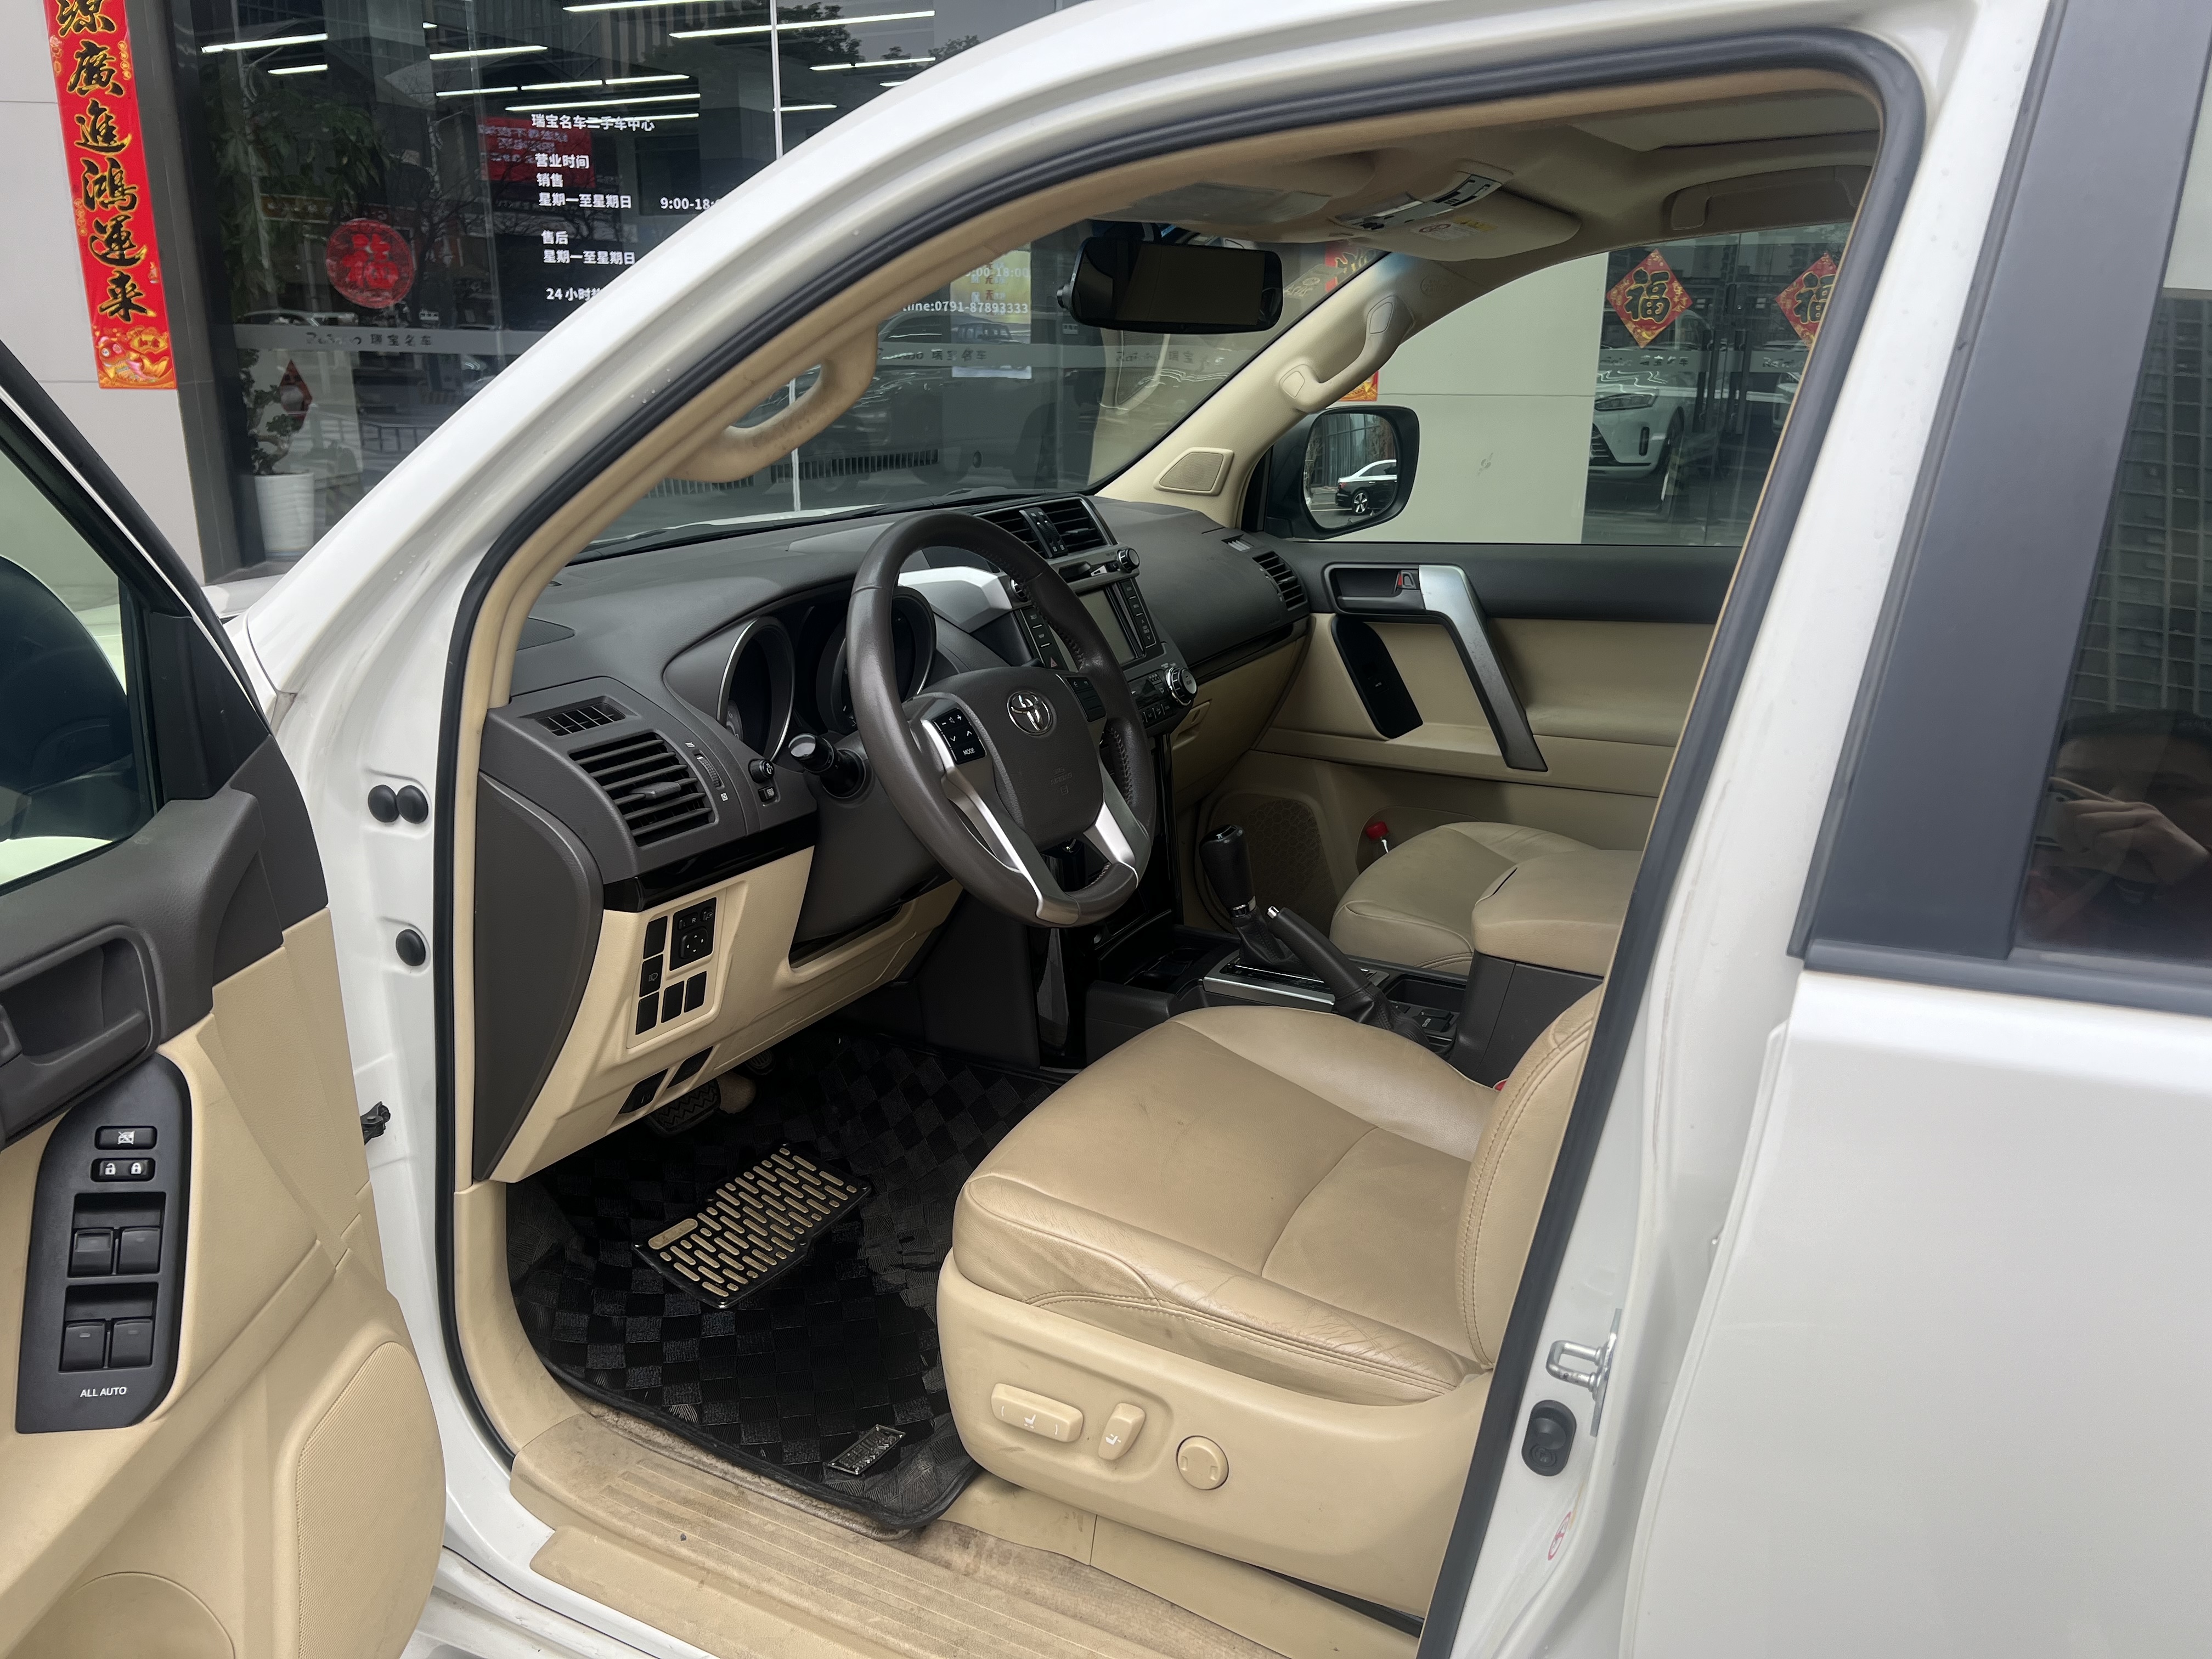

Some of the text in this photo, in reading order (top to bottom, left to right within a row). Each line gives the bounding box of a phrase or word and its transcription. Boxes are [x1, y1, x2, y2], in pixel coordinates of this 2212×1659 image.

[531, 114, 655, 131] 瑞宝名车二手车中心
[535, 153, 590, 168] 营业时间
[537, 173, 563, 187] 销售
[539, 192, 631, 208] 星期一至星期日
[541, 230, 568, 245] 售后
[544, 249, 635, 264] 星期一至星期日
[546, 287, 562, 300] 24
[1624, 267, 1671, 323] 福
[962, 747, 976, 756] MODE
[80, 1386, 127, 1397] ALL AUTO
